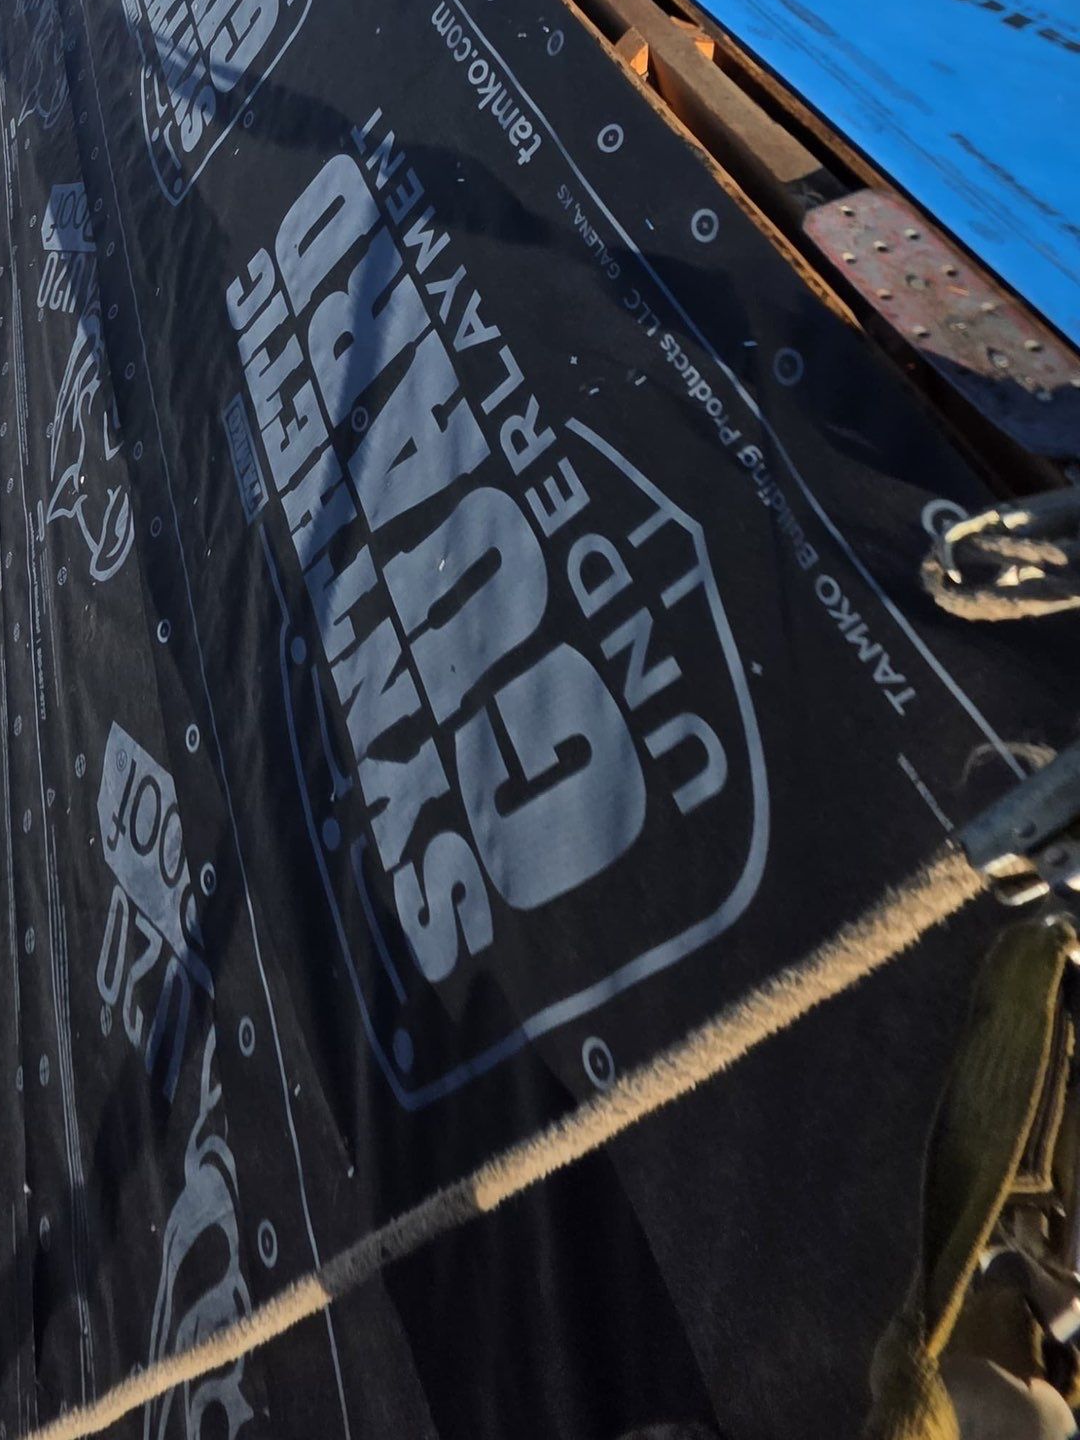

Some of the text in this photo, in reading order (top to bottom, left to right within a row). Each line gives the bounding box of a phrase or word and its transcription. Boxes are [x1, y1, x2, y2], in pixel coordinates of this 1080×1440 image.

[226, 405, 265, 511] TAMKO
[226, 248, 493, 982] SYNTHETIC
[275, 154, 646, 912] GUARD
[350, 107, 727, 816] UNDERLAYMENT
[430, 1, 916, 716] TAMKO Building Products LLC GALENA, KS tamko.com
[97, 884, 191, 1104] U20
